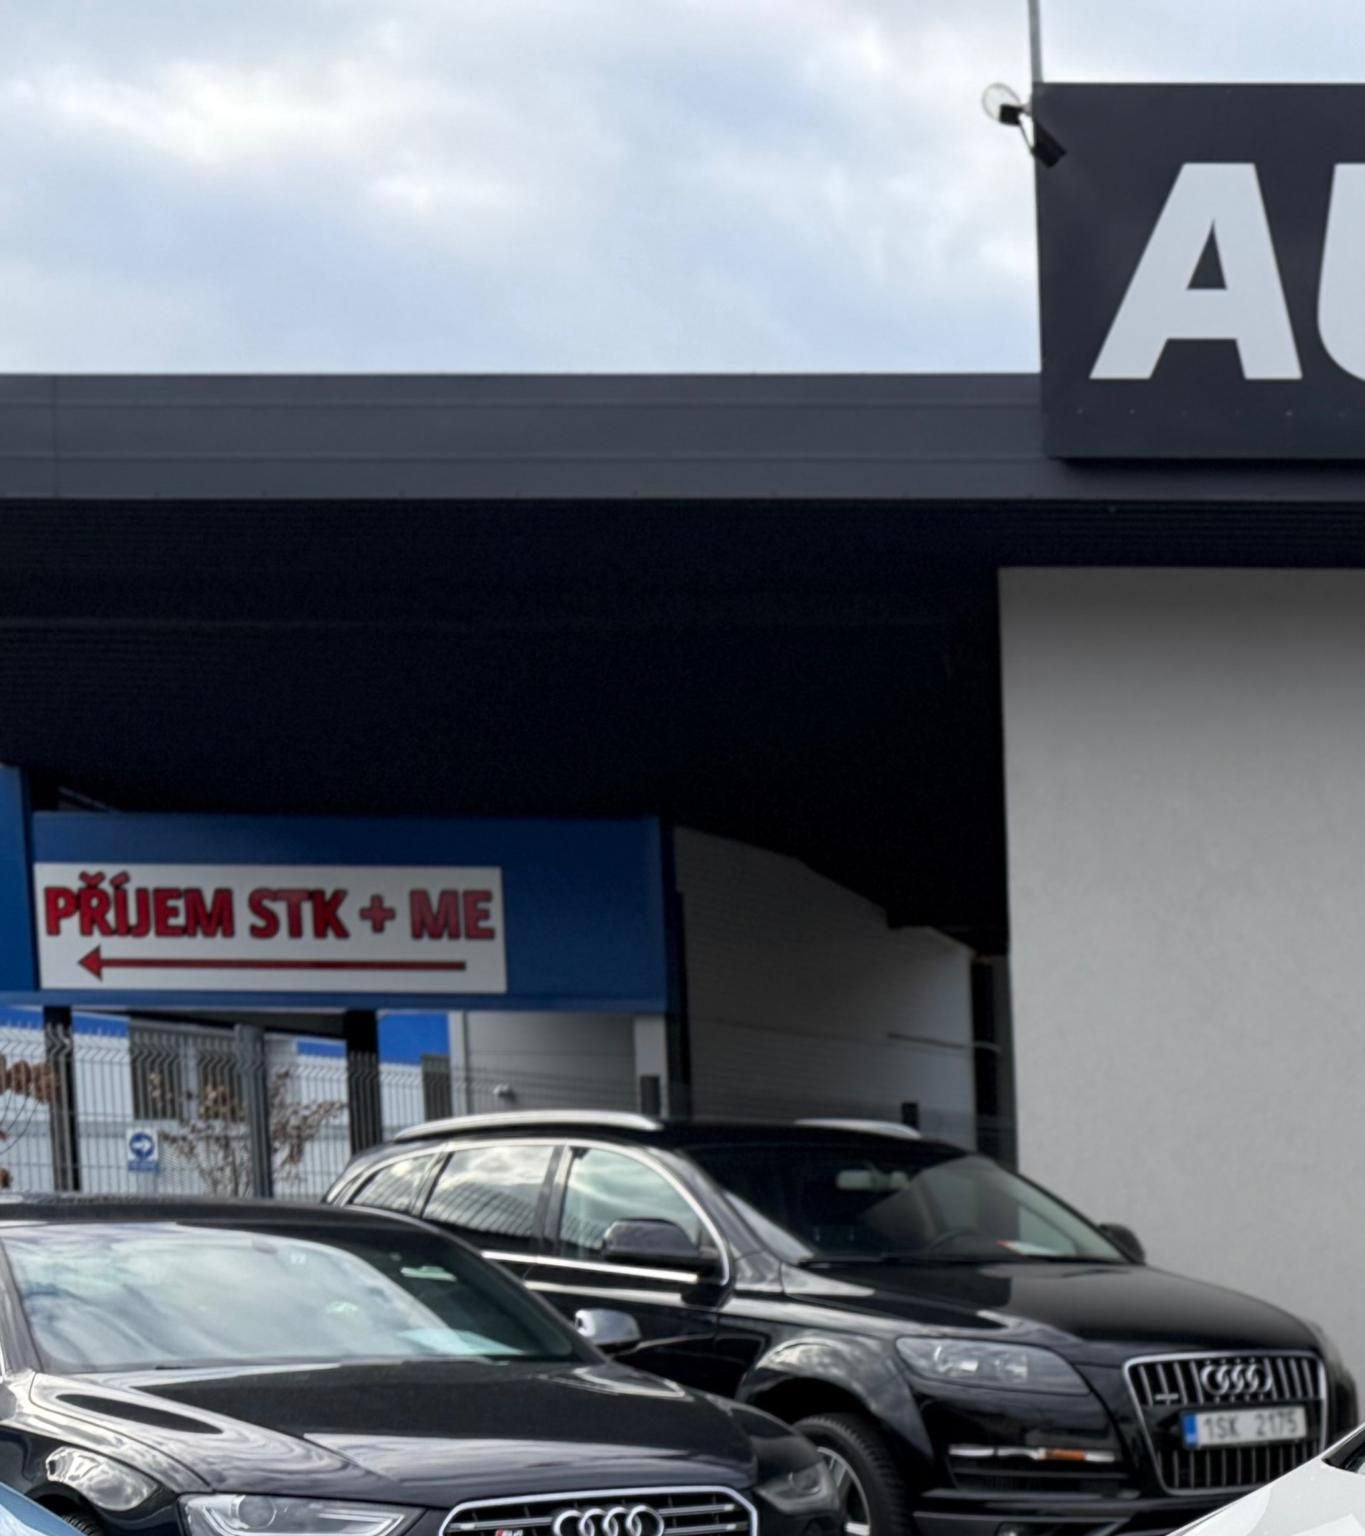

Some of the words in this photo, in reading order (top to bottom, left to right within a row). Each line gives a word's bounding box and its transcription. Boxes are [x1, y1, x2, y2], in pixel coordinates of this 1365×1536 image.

[44, 870, 235, 938] PŘÍJEM
[248, 887, 349, 939] STK
[409, 889, 496, 940] ME
[1255, 1410, 1299, 1438] 2175
